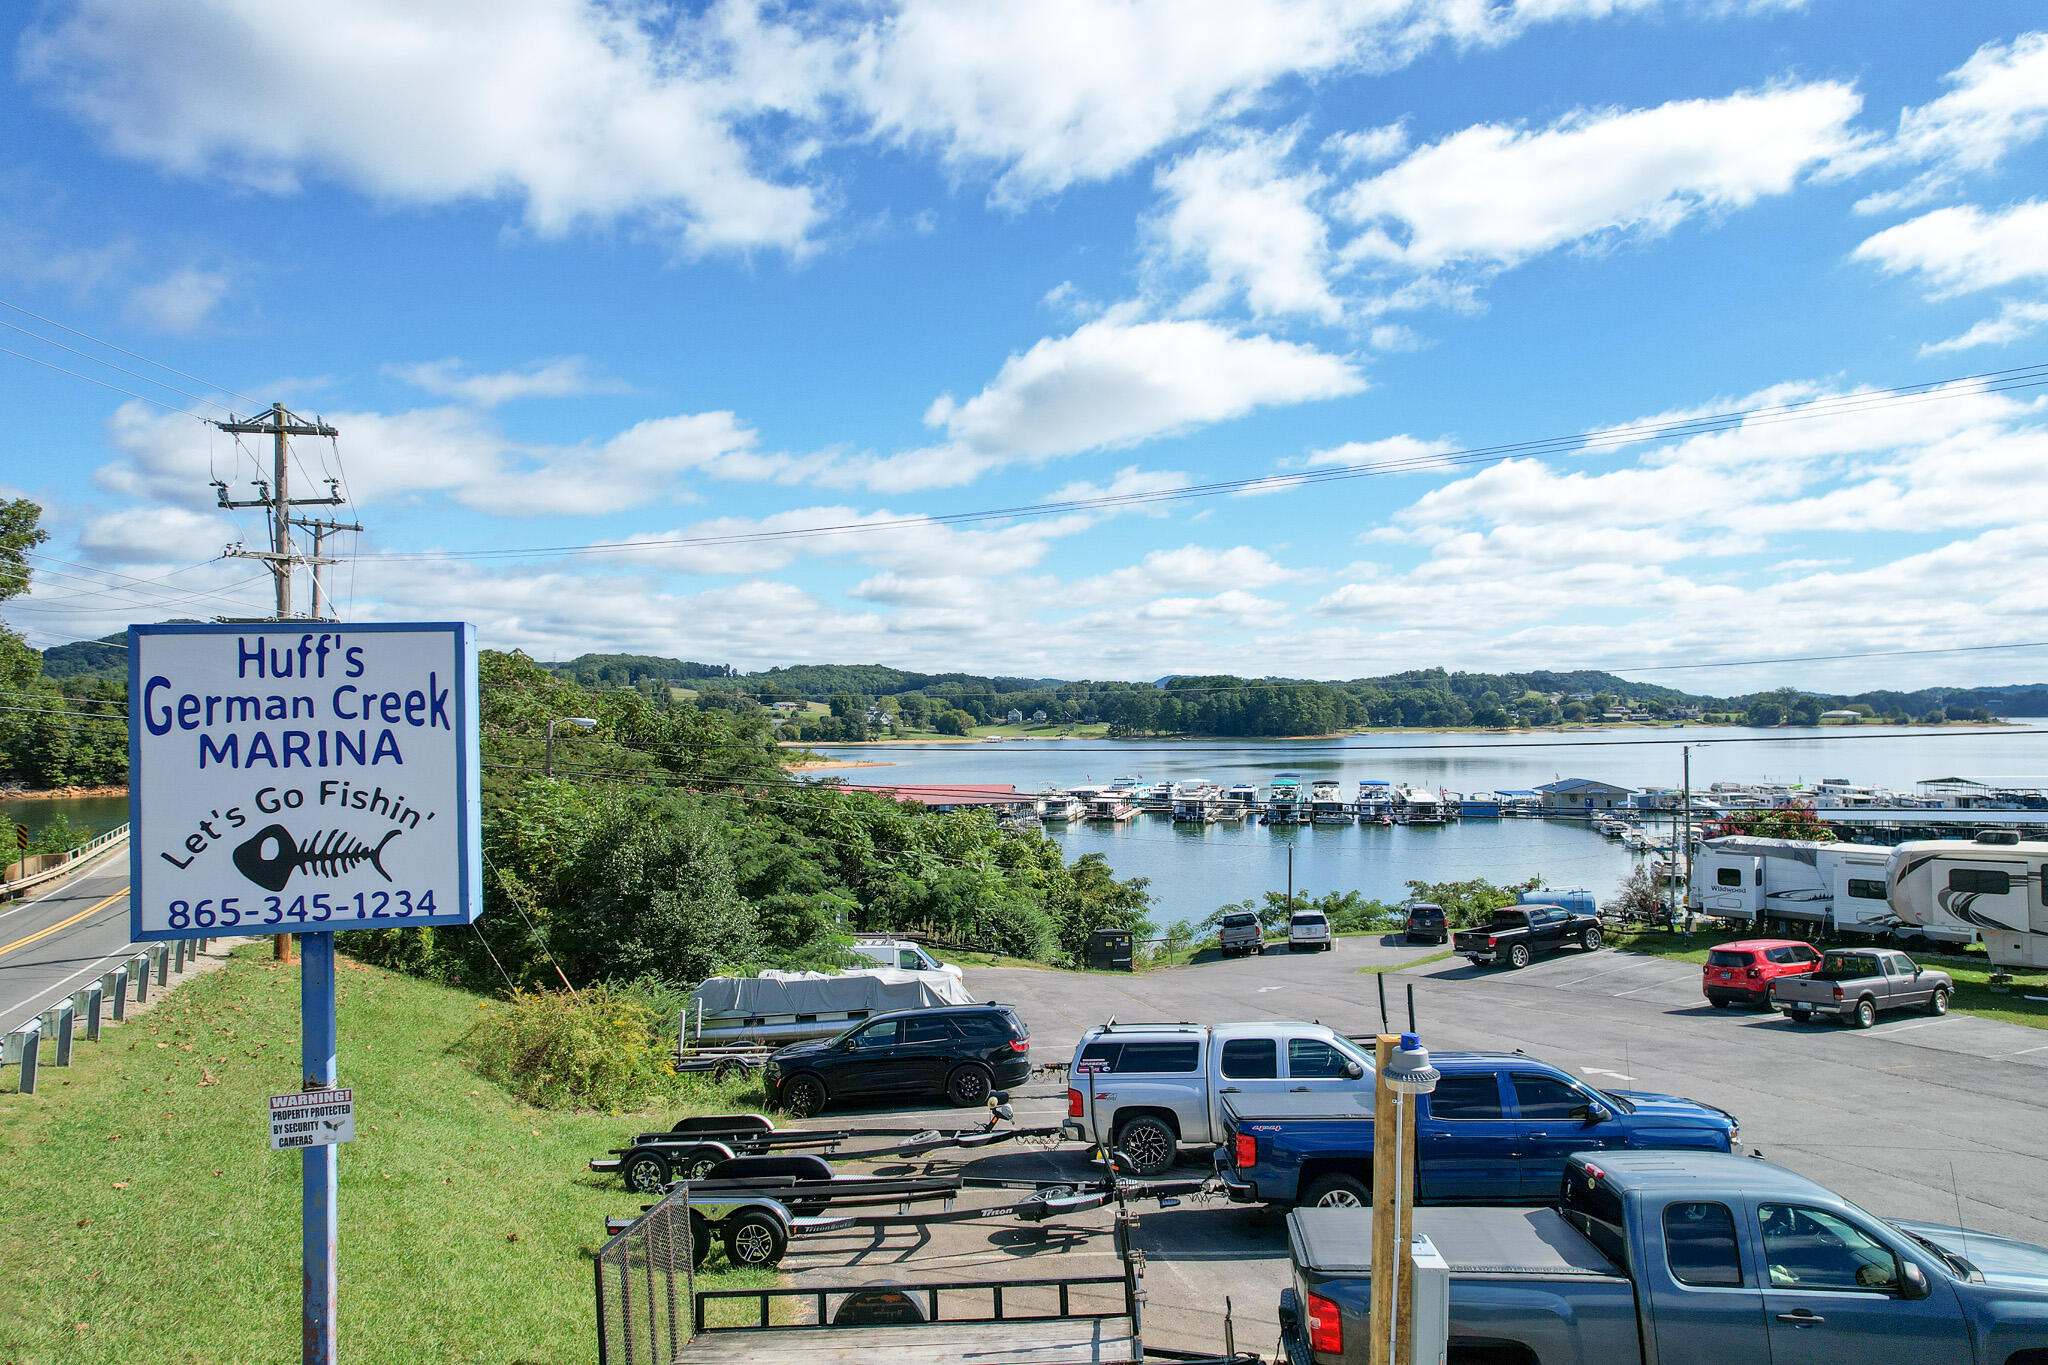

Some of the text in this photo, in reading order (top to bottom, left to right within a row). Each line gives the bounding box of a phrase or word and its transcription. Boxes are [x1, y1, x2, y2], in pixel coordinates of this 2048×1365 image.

[238, 634, 364, 679] Huff's
[144, 671, 451, 736] German Creek
[200, 729, 403, 769] MARINA
[160, 780, 436, 870] Let's Go Fishin'
[1711, 885, 1747, 893] Wildwood
[168, 889, 437, 929] 865-345-1234
[271, 1090, 350, 1108] WARNING!
[272, 1104, 351, 1121] PROPERTY PROTECTED
[273, 1121, 319, 1134] BY SECURITY
[278, 1134, 313, 1148] CAMERAS
[981, 1208, 1014, 1217] Triton
